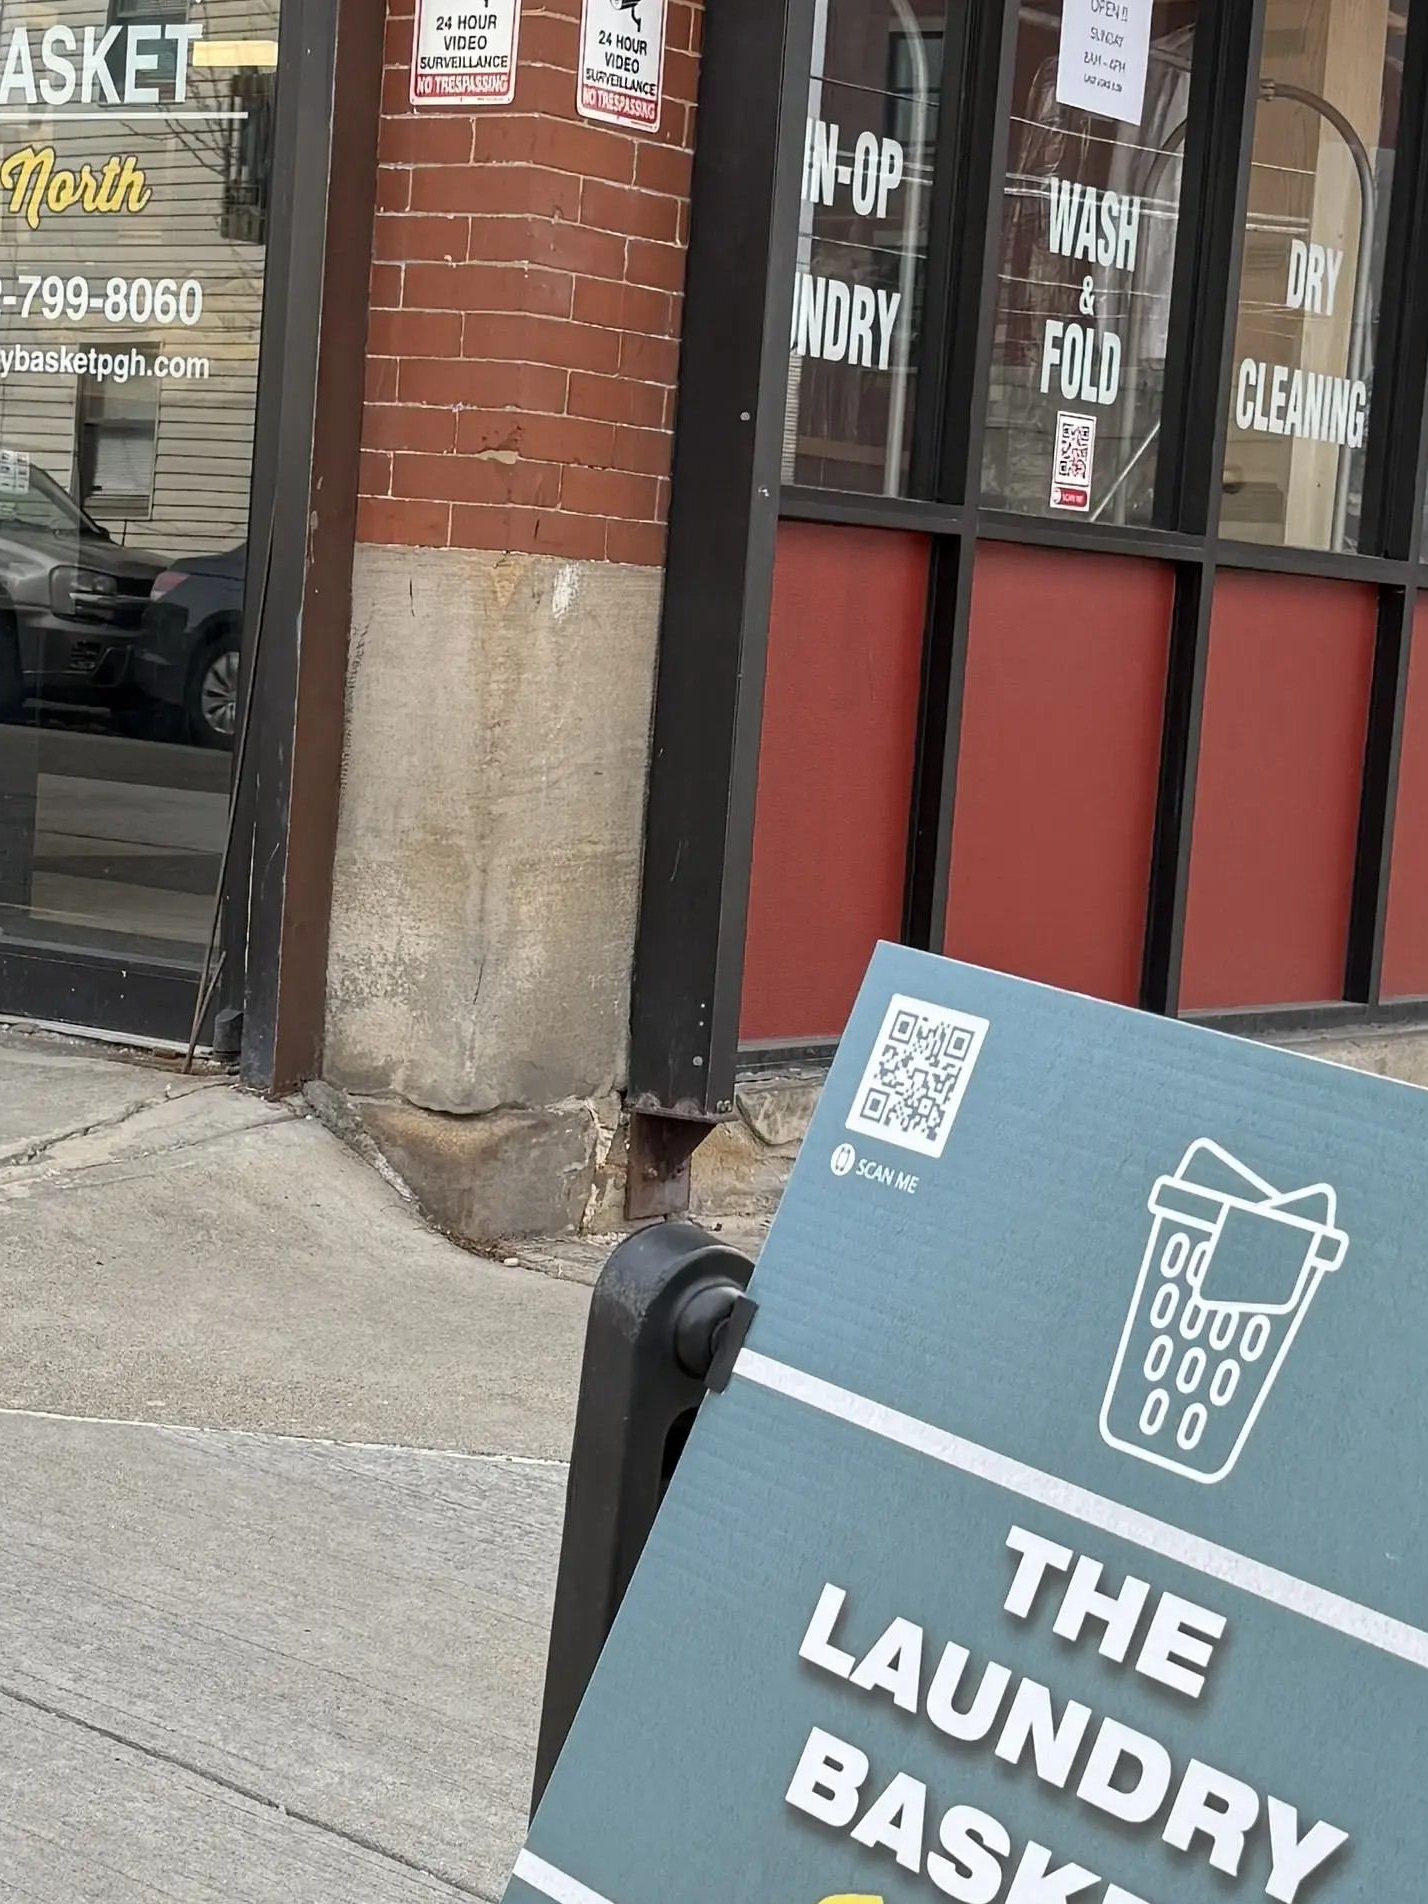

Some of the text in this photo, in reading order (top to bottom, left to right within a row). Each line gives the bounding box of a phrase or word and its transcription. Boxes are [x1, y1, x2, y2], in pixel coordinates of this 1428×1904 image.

[435, 14, 497, 31] 24 HOUR
[443, 36, 488, 51] VIDEO
[598, 30, 647, 56] 24 HOUR
[420, 55, 508, 70] SURVEILLANCE
[604, 52, 640, 72] VIDEO
[417, 75, 508, 93] NO TRESPASSING
[586, 68, 656, 96] SURVEILLANCE
[583, 87, 656, 120] NO TRESPASSING
[0, 145, 152, 230] North
[1049, 176, 1141, 272] WASH
[1079, 275, 1095, 316] &
[1286, 239, 1343, 316] DRY
[1040, 319, 1121, 405] FOLD
[1236, 357, 1367, 448] CLEANING
[856, 1158, 920, 1194] SCAN ME
[1003, 1525, 1227, 1699] THE
[798, 1582, 1349, 1904] LAUNDRY
